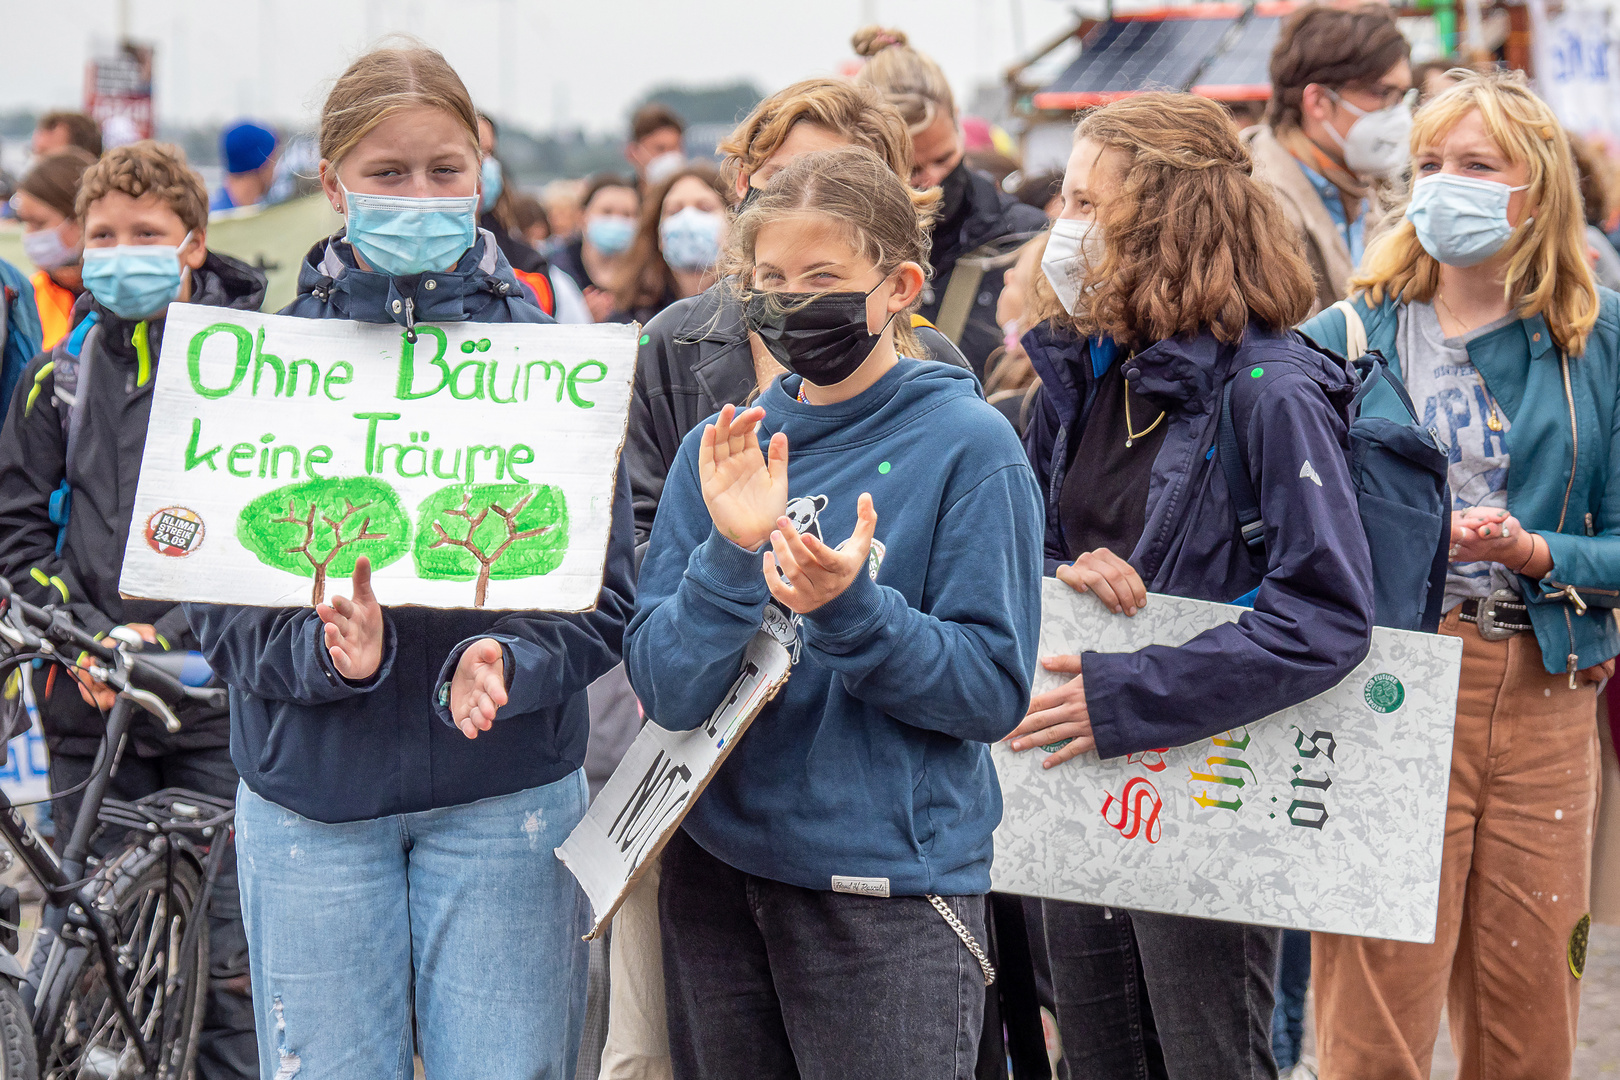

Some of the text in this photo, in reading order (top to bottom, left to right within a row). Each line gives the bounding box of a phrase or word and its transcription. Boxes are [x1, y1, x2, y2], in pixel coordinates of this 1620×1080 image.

[187, 322, 608, 409] Ohne Bäume
[1433, 366, 1477, 379] UNIVER
[184, 412, 535, 484] keine Träume
[158, 523, 193, 540] STREIK
[162, 514, 196, 532] KLIMA
[154, 530, 187, 548] 24.09.
